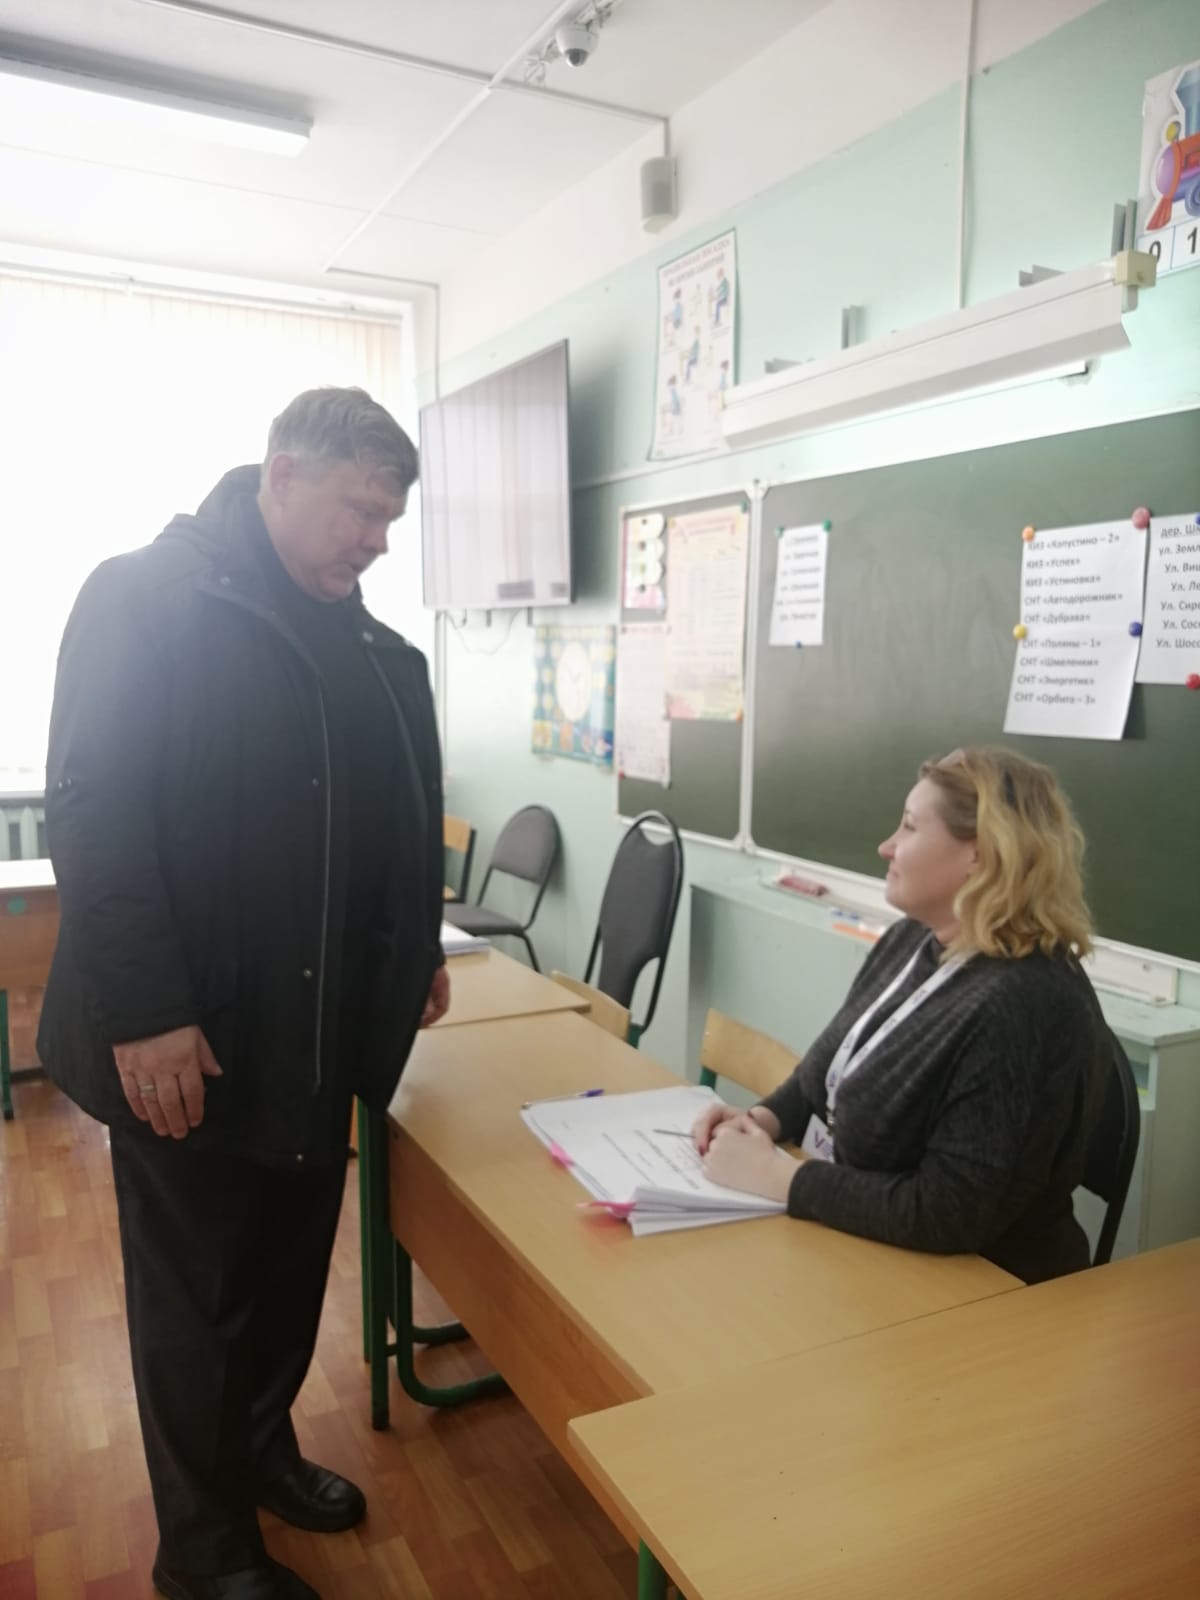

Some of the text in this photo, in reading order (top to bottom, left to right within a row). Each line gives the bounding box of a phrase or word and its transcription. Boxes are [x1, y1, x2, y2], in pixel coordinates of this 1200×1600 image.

[1187, 226, 1198, 254] 1
[1160, 527, 1182, 539] дер.
[1159, 546, 1172, 556] ул.
[1165, 562, 1180, 573] Ул.
[1170, 581, 1186, 592] Ул.
[1160, 600, 1176, 611] Ул.
[1162, 619, 1178, 630] Ул.
[1156, 638, 1172, 649] Ул.
[1020, 656, 1038, 667] СНТ
[1017, 674, 1036, 685] СНТ
[1014, 691, 1034, 703] СНТ
